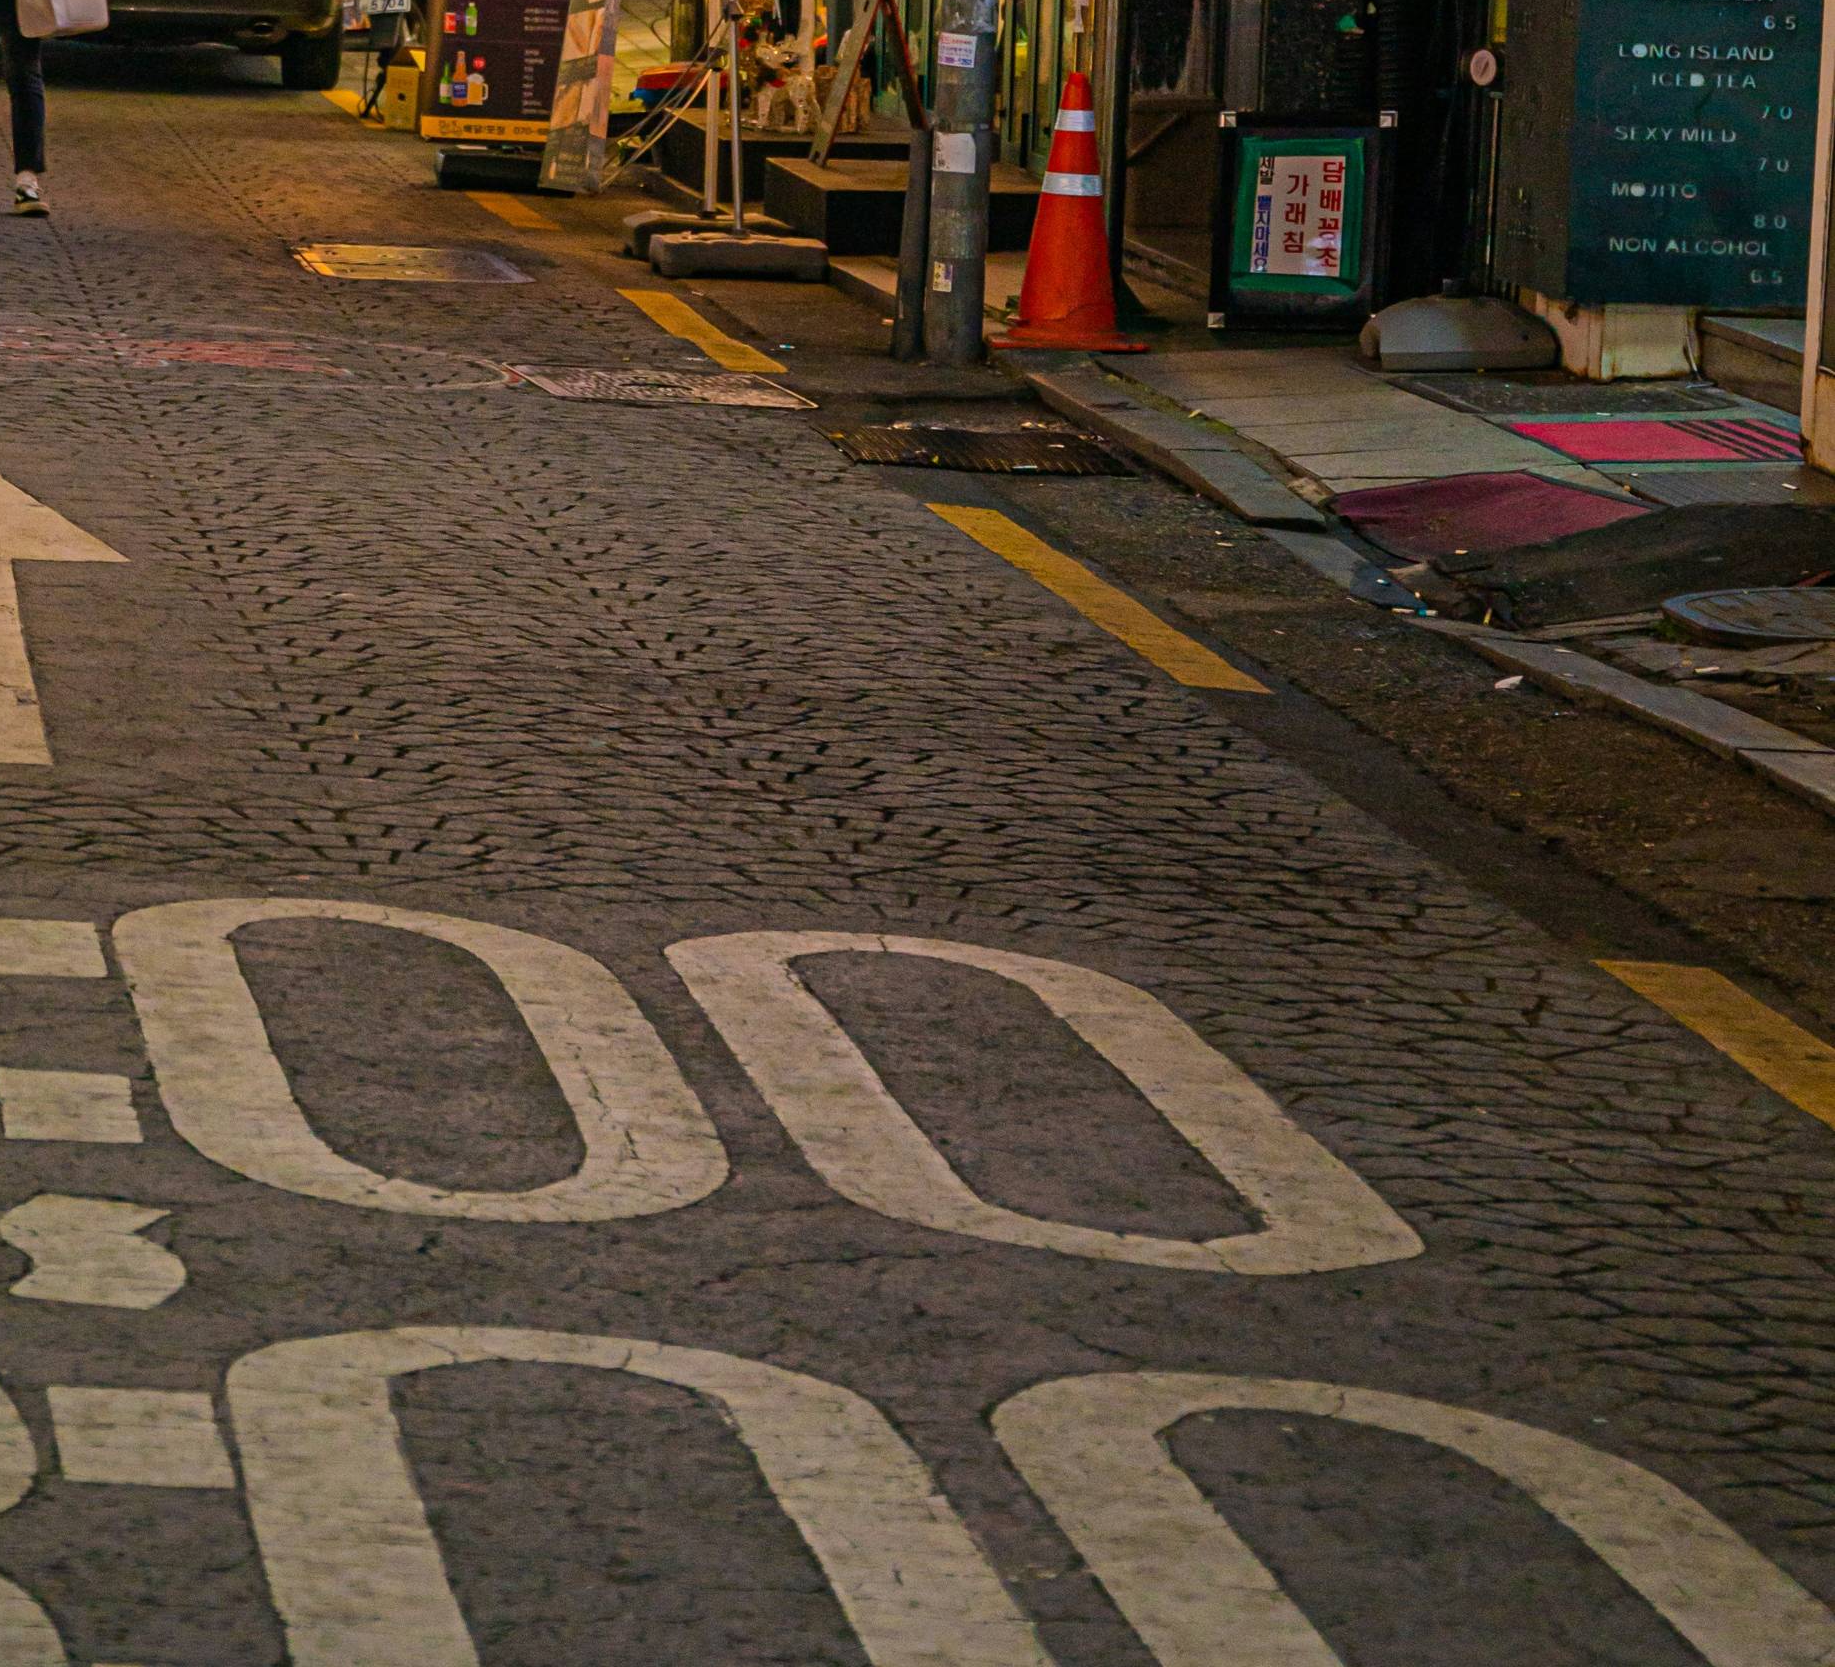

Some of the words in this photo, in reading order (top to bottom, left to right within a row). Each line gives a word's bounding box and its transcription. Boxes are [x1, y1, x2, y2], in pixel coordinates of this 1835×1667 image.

[1619, 43, 1681, 60] LONG
[1689, 45, 1775, 62] ISLAND
[1651, 73, 1706, 88] ICED
[1715, 74, 1757, 89] TEA
[1614, 126, 1674, 142] SEXY
[1611, 182, 1698, 199] MOJITO
[1283, 174, 1309, 254] 가래침
[1316, 161, 1345, 268] 담배꽁초
[1608, 237, 1657, 253] NON
[1664, 239, 1772, 256] ALCOHOL
